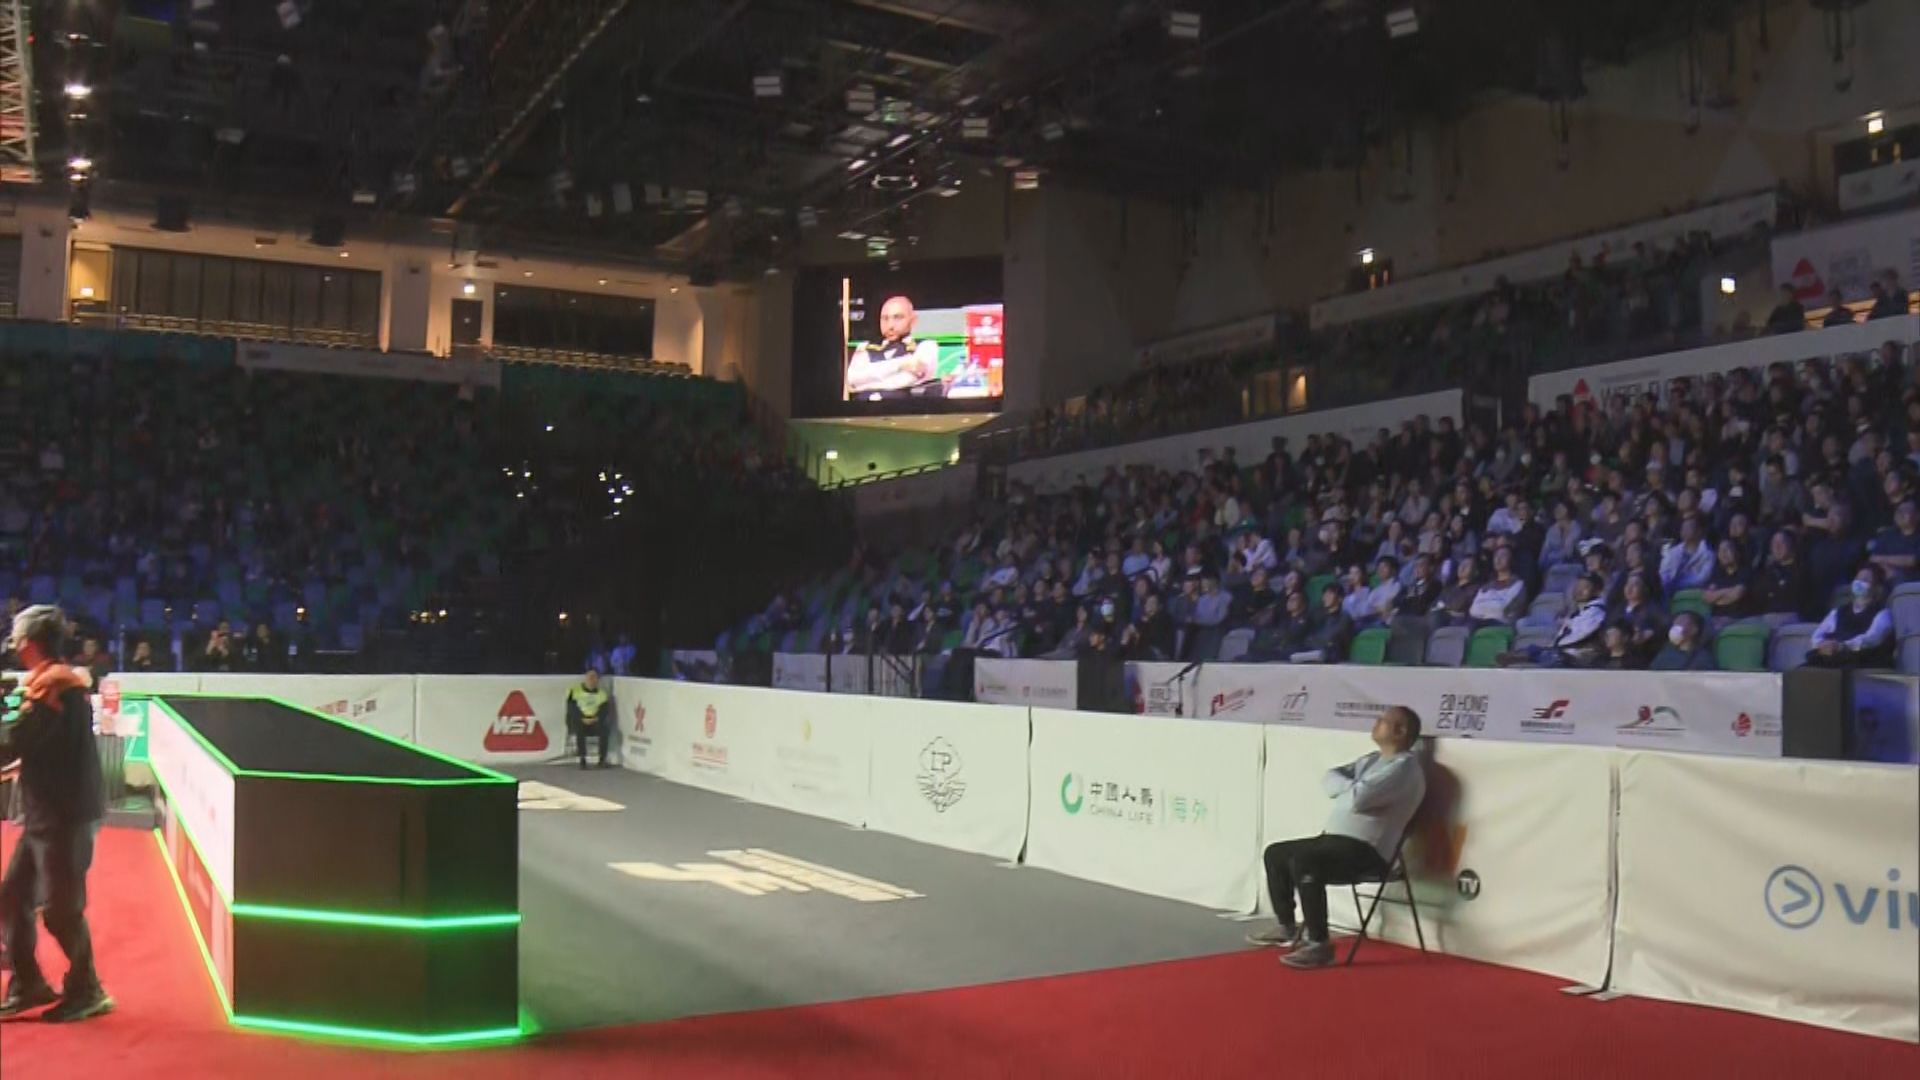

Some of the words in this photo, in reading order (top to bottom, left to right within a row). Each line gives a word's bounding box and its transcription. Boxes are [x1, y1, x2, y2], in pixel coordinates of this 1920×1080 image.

[493, 716, 536, 735] WST
[1459, 878, 1479, 894] TV
[1833, 868, 1919, 930] vi
